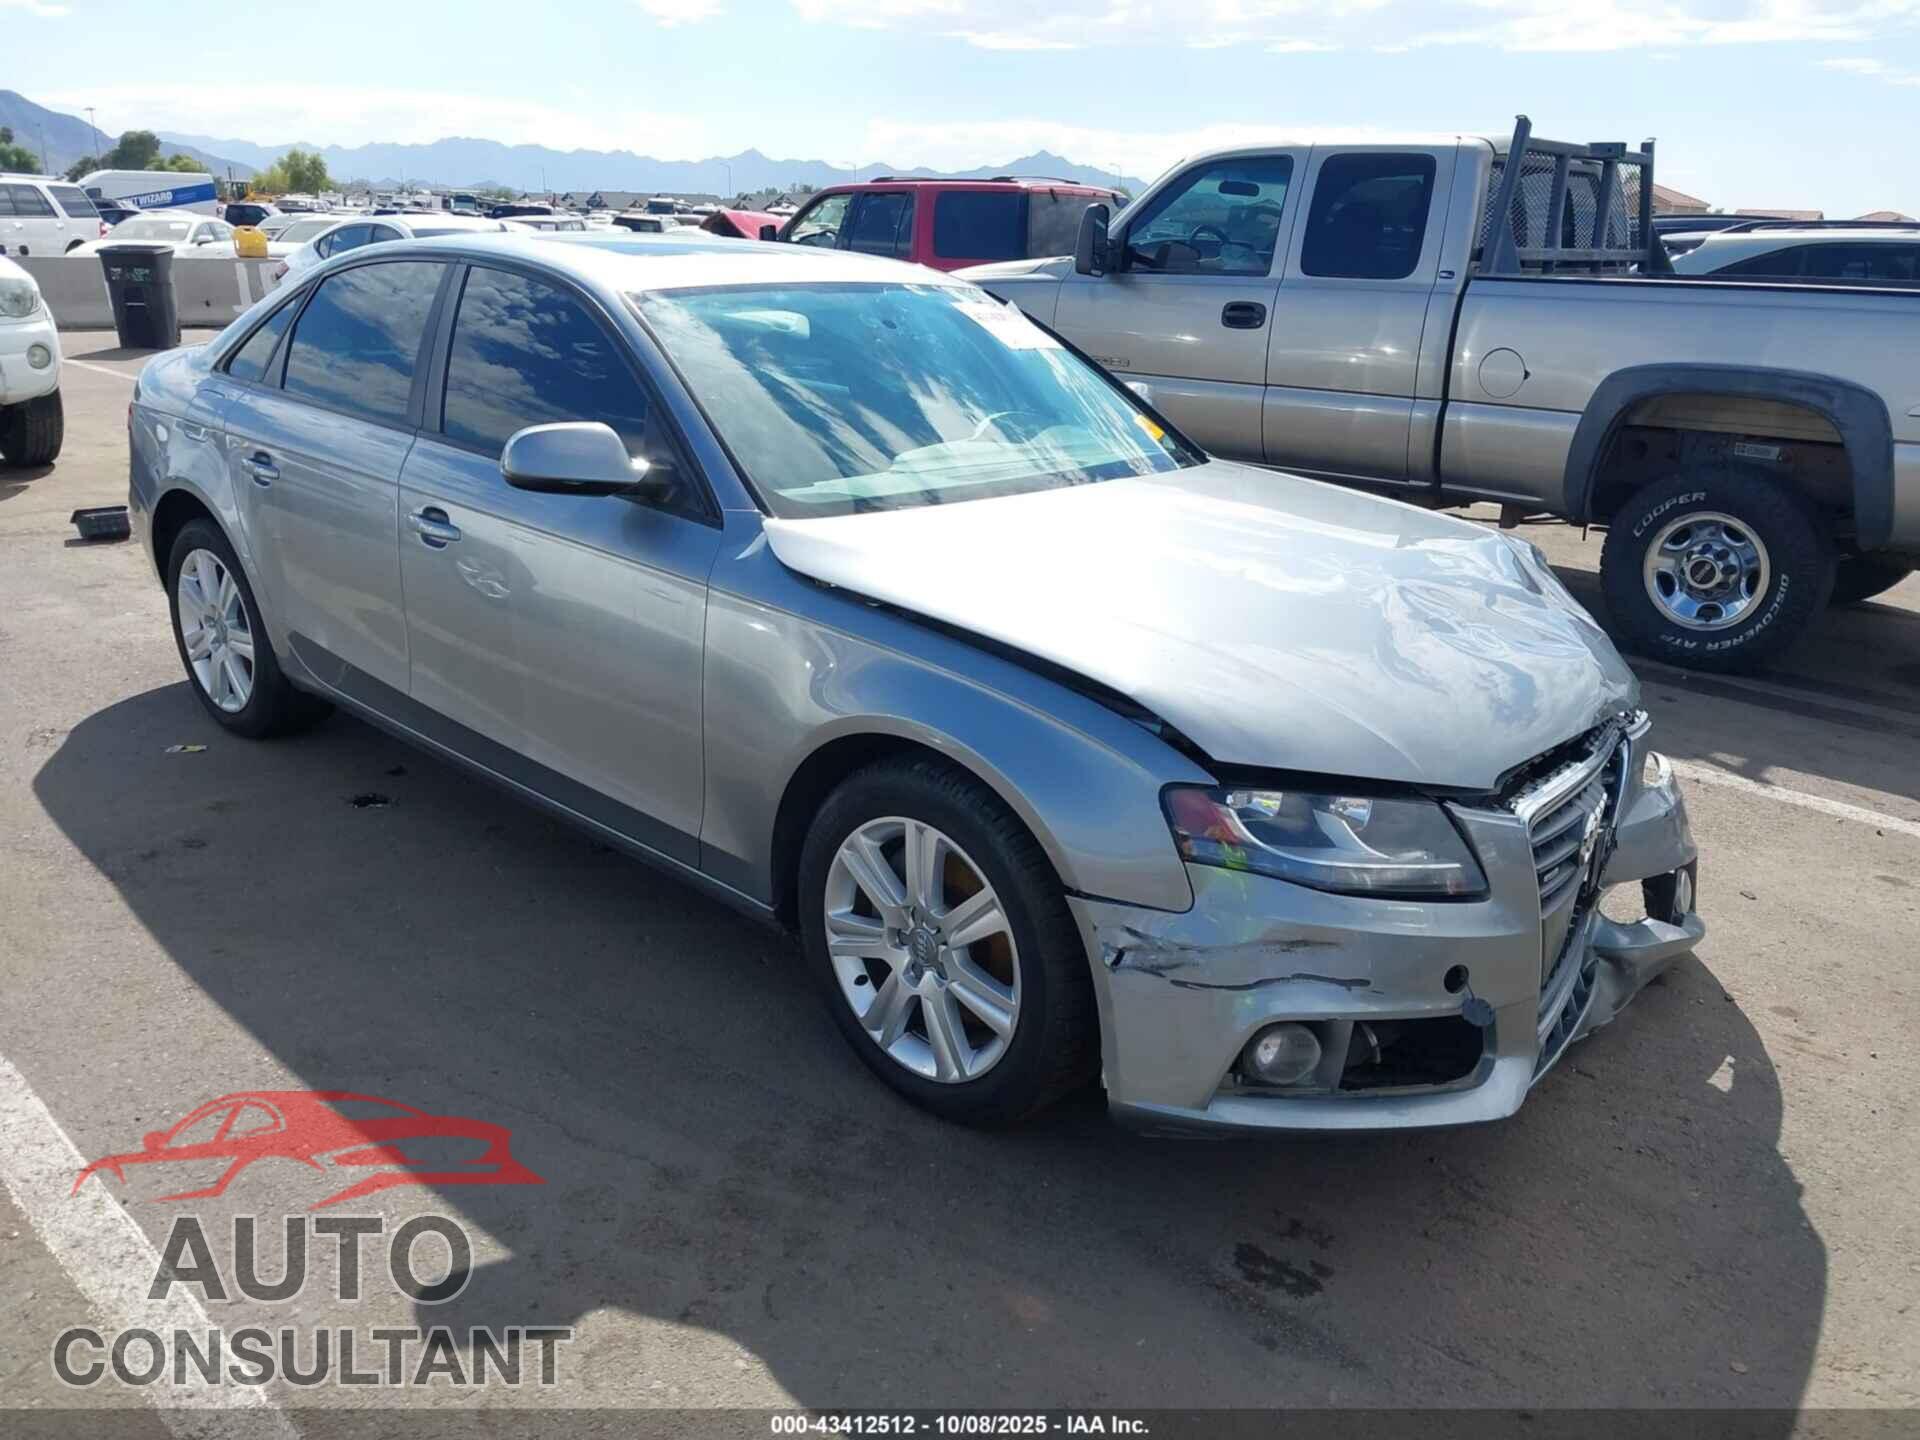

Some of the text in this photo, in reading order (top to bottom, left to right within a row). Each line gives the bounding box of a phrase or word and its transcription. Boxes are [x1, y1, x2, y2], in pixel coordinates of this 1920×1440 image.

[140, 191, 173, 205] WIZARD
[1633, 492, 1706, 537] COOPER
[1706, 574, 1789, 650] DISCOVERER
